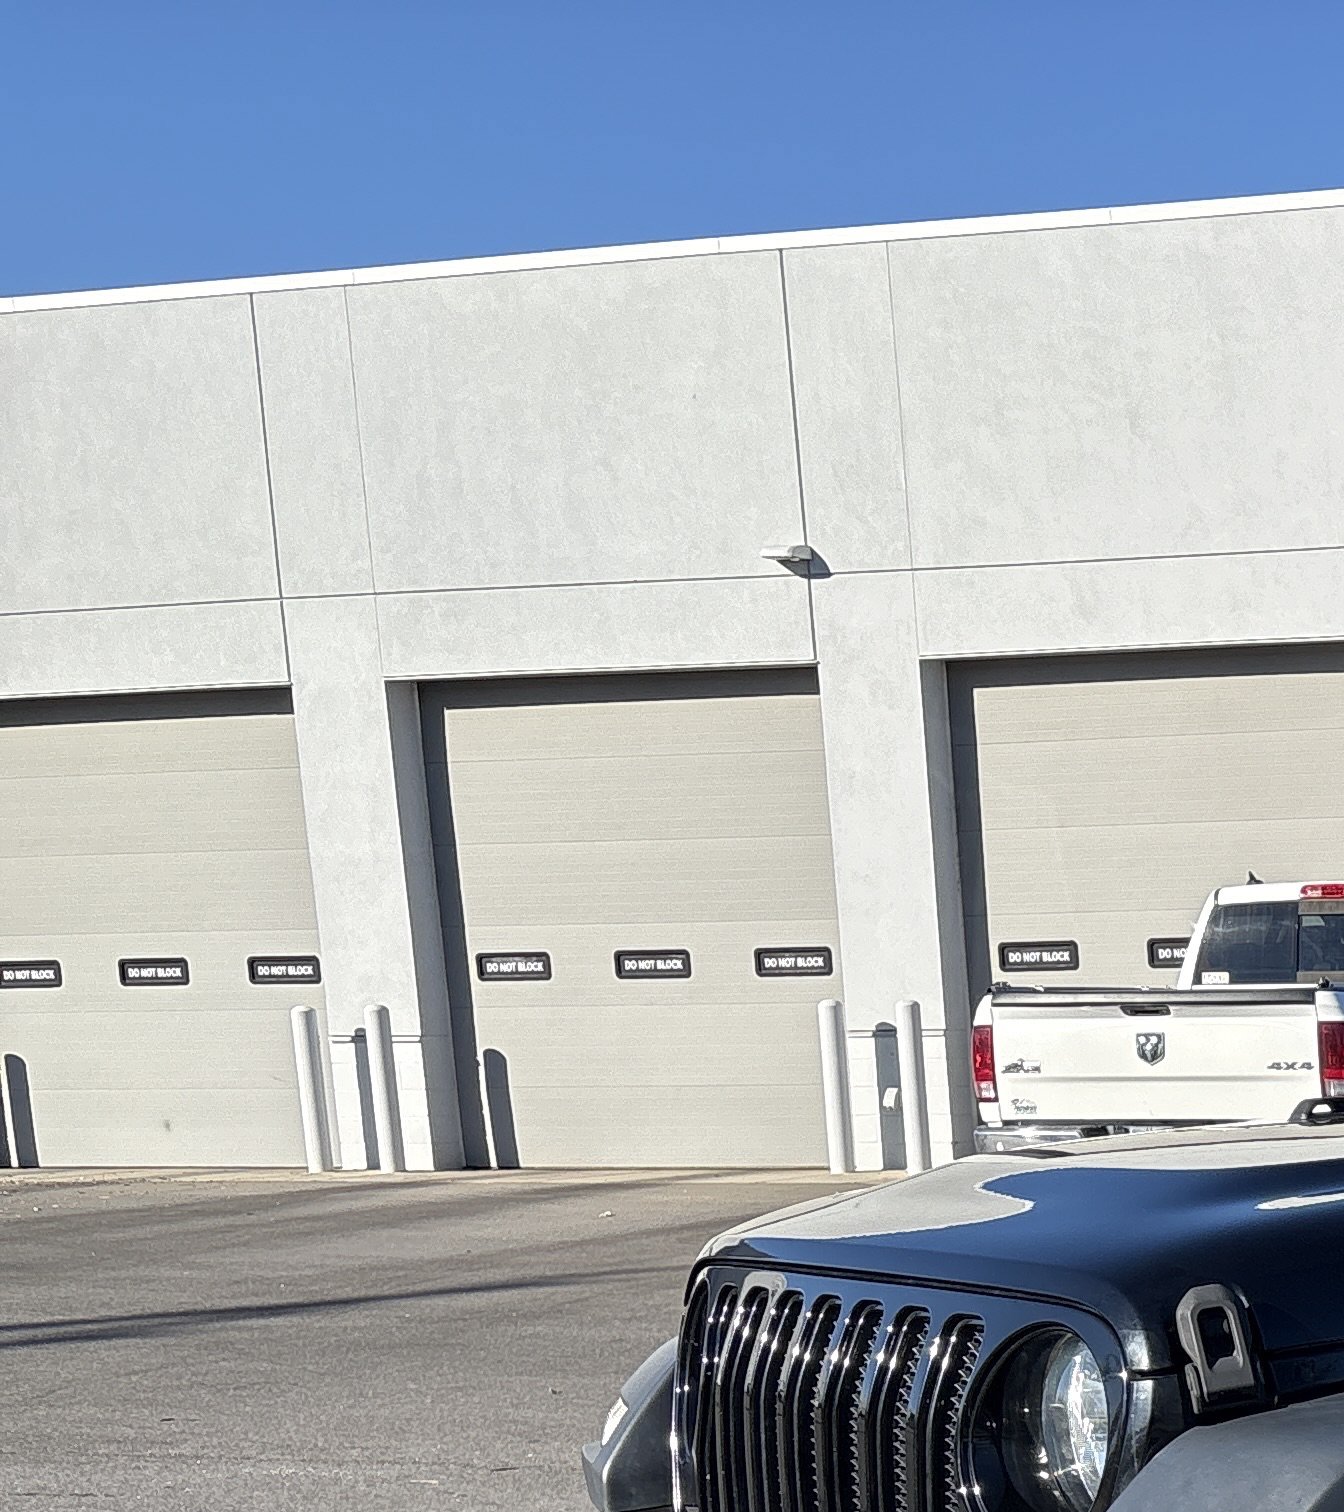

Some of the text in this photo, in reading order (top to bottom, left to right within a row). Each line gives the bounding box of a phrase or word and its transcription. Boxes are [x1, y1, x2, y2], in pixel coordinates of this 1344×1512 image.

[1008, 951, 1071, 963] DO NOT BLOCK
[1158, 947, 1187, 959] DO NO
[486, 961, 544, 973] DO NOT BLOCK
[624, 959, 684, 970] DO NOT BLOCK
[764, 956, 824, 968] DO NOT BLOCK
[3, 969, 55, 980] DO NOT BLOCK
[128, 967, 182, 978] DO NOT BLOCK
[257, 965, 314, 976] DO NOT BLOCK
[1267, 1061, 1314, 1071] 4X4
